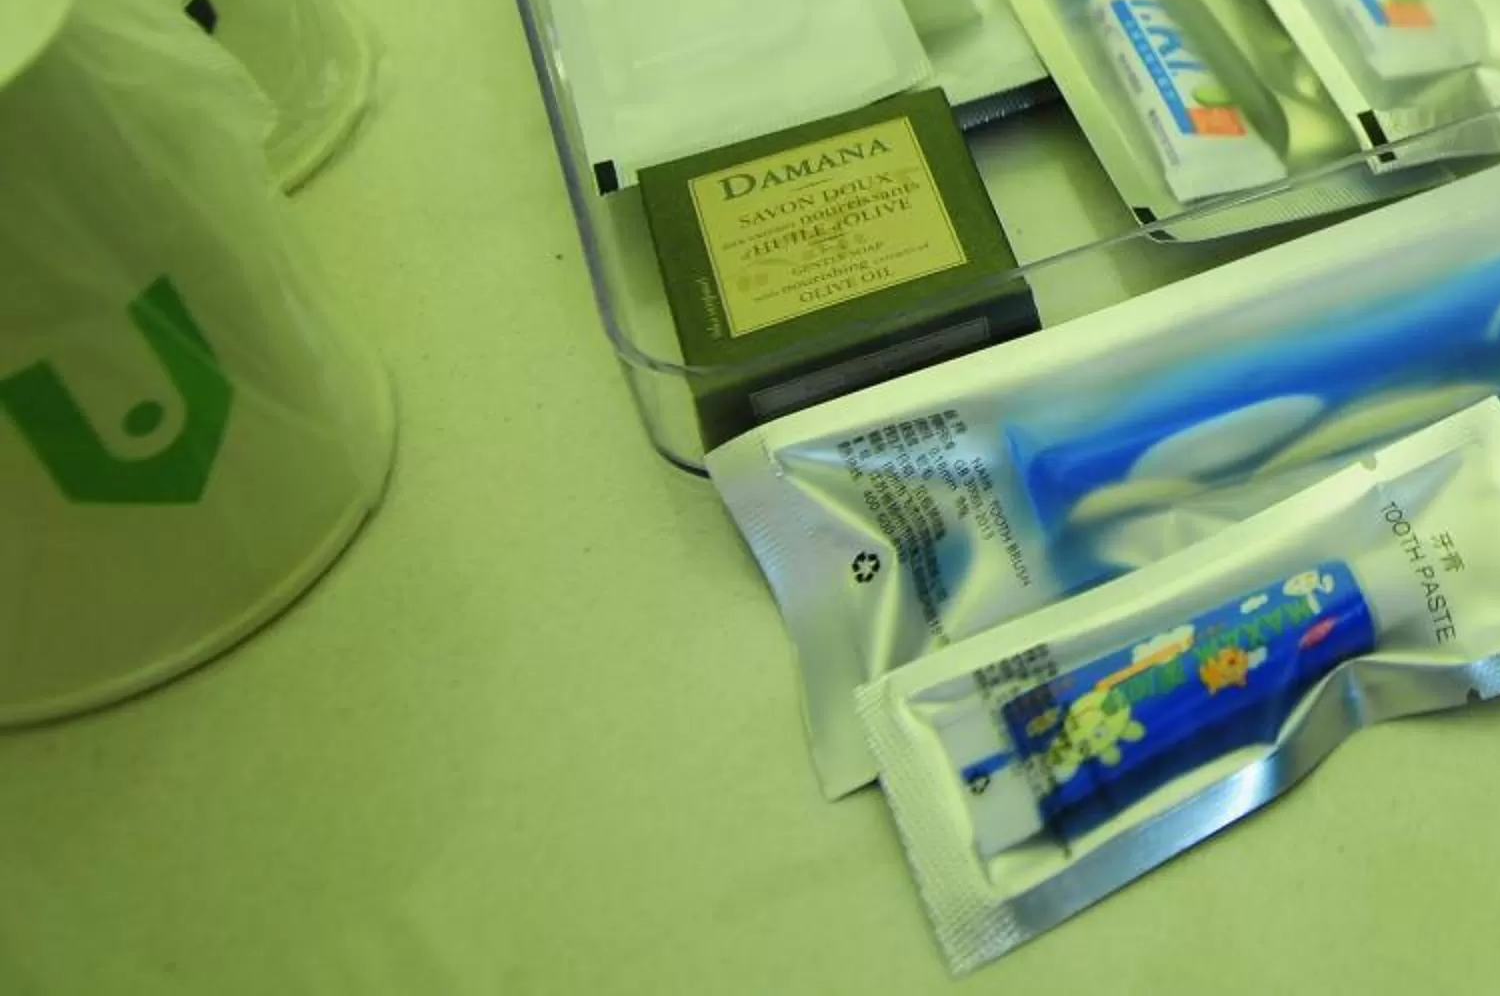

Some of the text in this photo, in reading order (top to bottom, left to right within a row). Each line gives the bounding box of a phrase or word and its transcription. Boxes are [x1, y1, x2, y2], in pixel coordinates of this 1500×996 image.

[719, 138, 891, 201] DAMANA
[738, 171, 899, 229] SAVON DOUX
[1379, 501, 1456, 645] TOOTH PASTE
